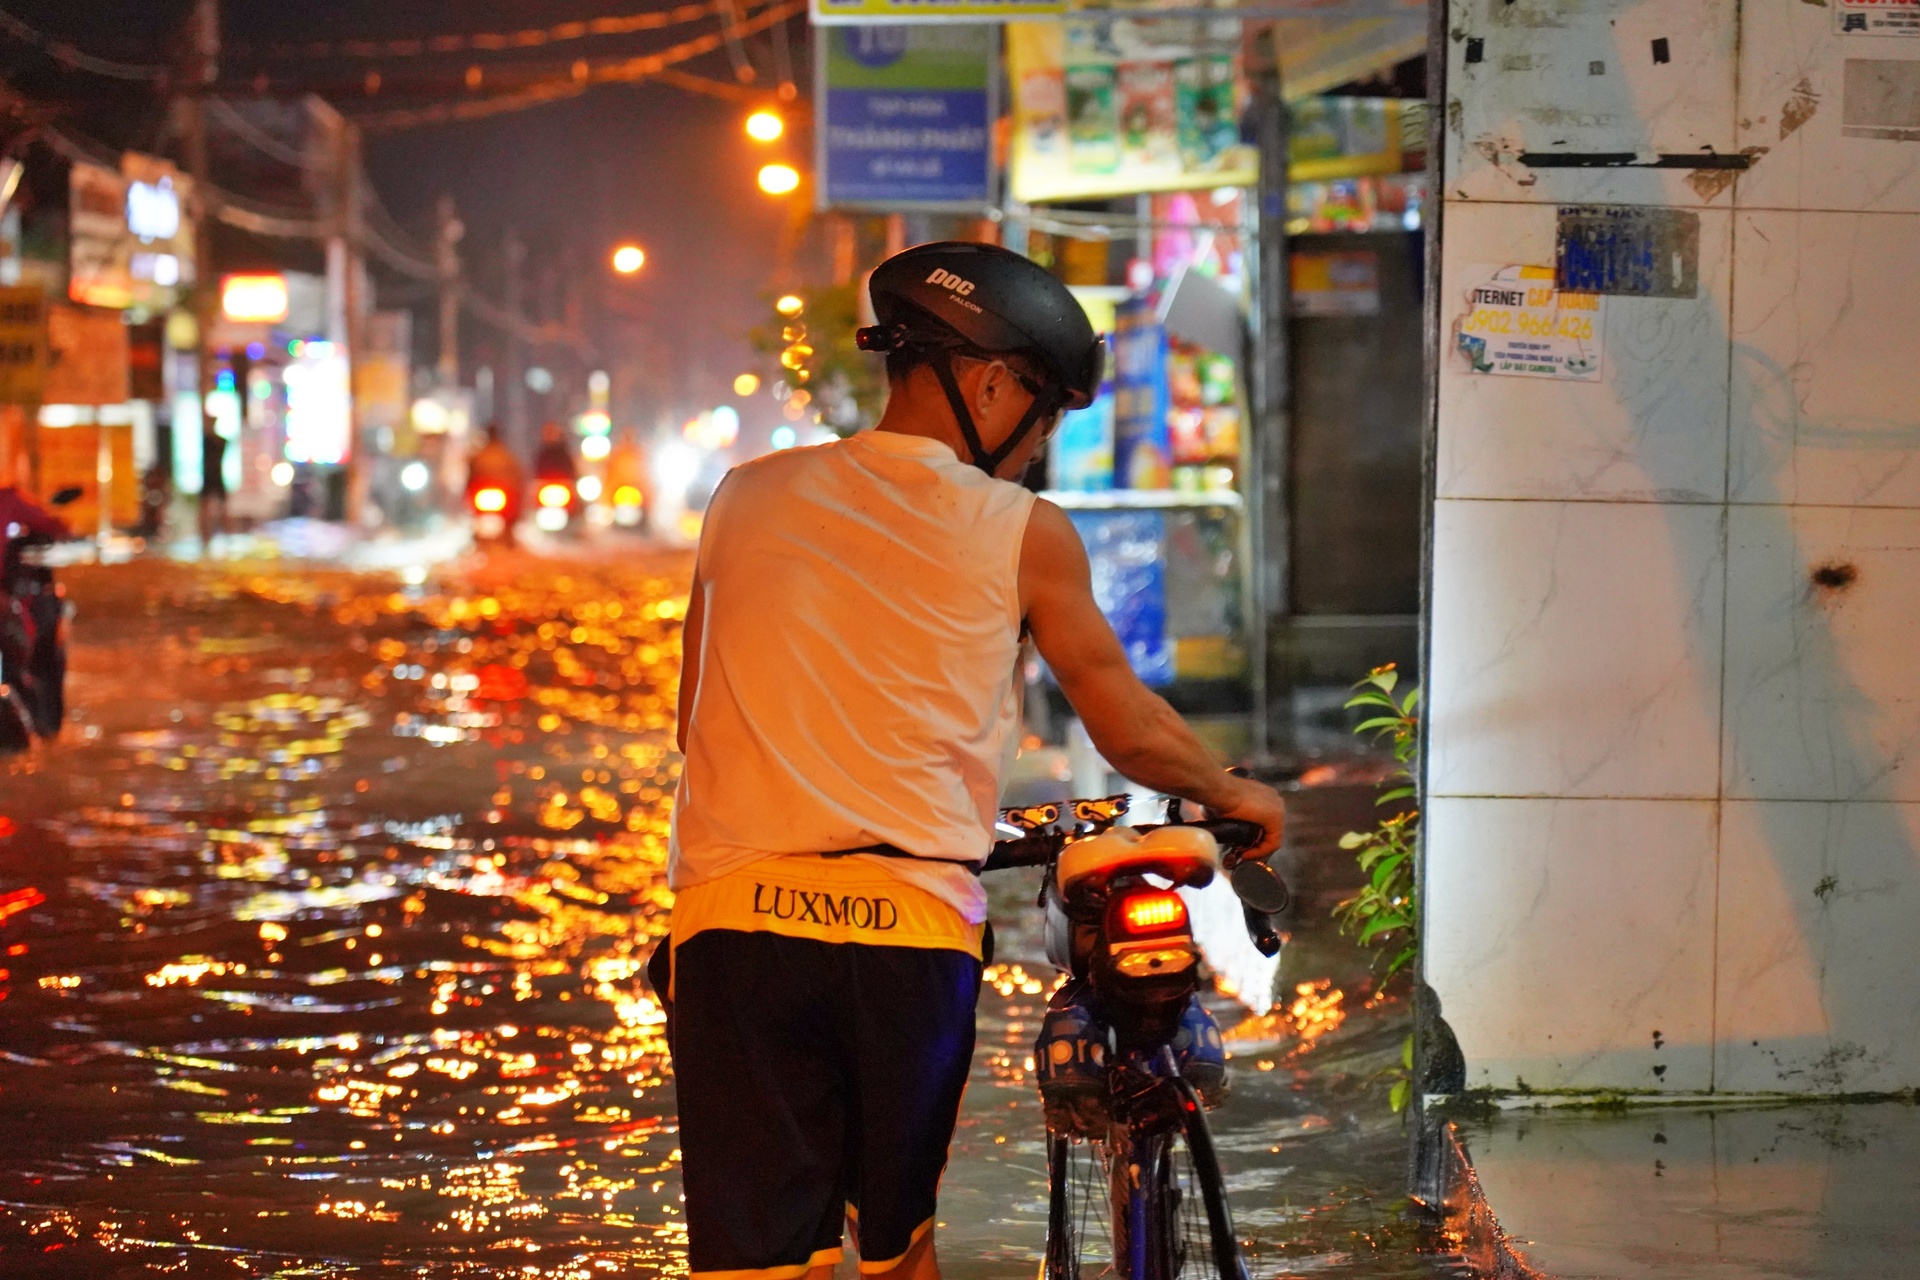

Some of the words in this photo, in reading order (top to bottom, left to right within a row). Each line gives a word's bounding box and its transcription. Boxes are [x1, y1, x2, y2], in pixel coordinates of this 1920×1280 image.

[949, 294, 983, 314] FALCON
[753, 882, 898, 931] LUXMOD
[1039, 1039, 1105, 1079] pro
